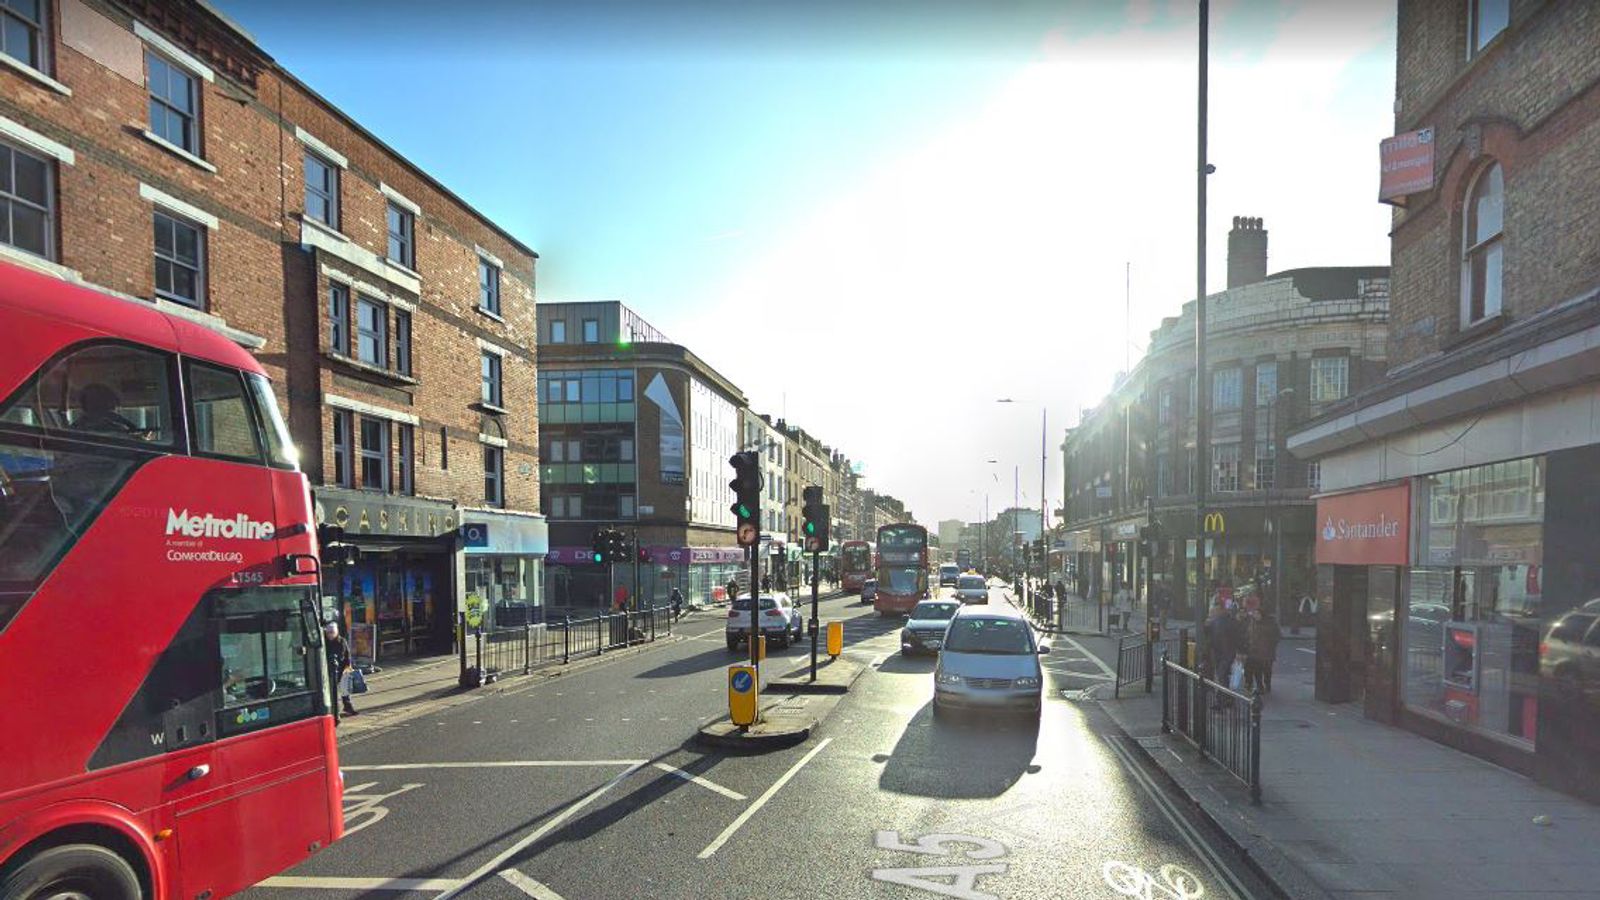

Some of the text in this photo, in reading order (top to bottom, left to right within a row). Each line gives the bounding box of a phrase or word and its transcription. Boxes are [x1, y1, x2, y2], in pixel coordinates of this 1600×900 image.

[165, 507, 275, 541] Metroline
[1336, 512, 1399, 539] Santander
[151, 732, 164, 745] W
